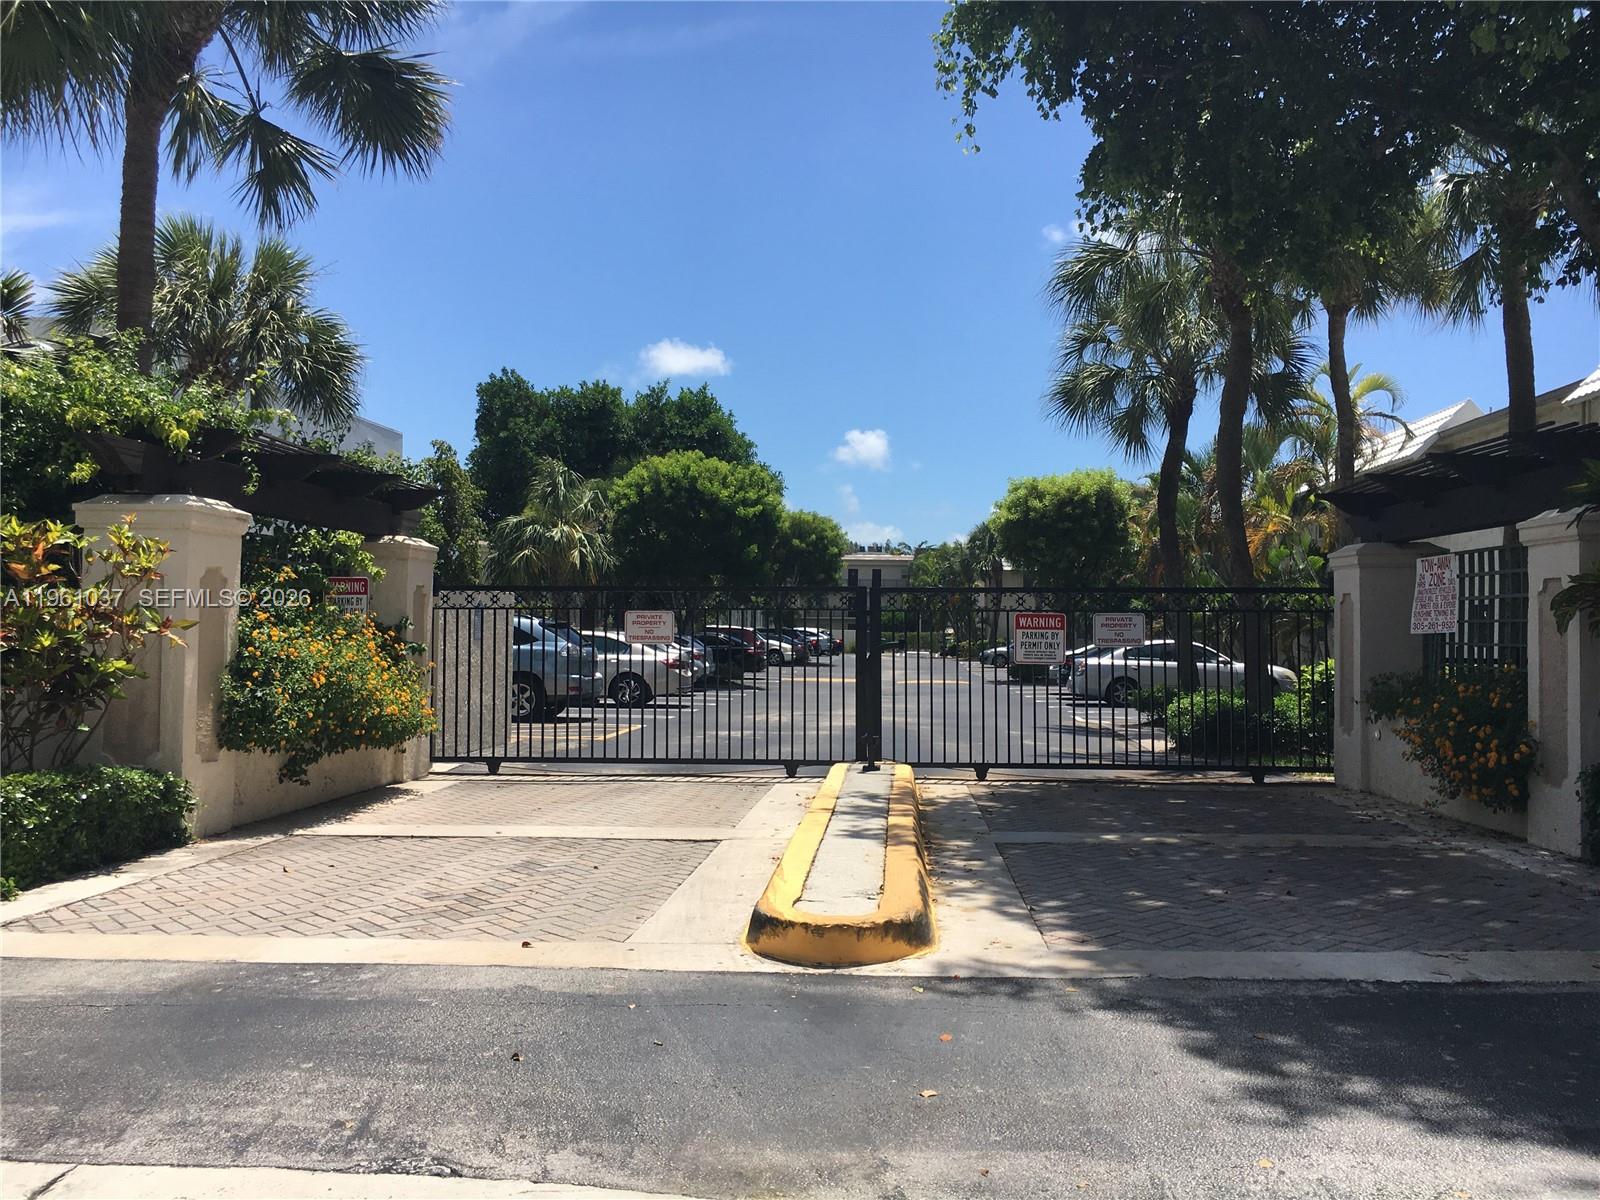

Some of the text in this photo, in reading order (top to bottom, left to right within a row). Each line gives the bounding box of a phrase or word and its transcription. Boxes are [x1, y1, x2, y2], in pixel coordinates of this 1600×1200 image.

[1420, 556, 1451, 573] TOW-AWAY
[1429, 571, 1446, 587] ZONE
[355, 597, 363, 606] BY
[1019, 617, 1061, 628] WARNING
[1412, 620, 1456, 631] 305-261-9520
[1021, 631, 1060, 640] PARKING BY
[1020, 641, 1060, 650] PERMIT ONLY
